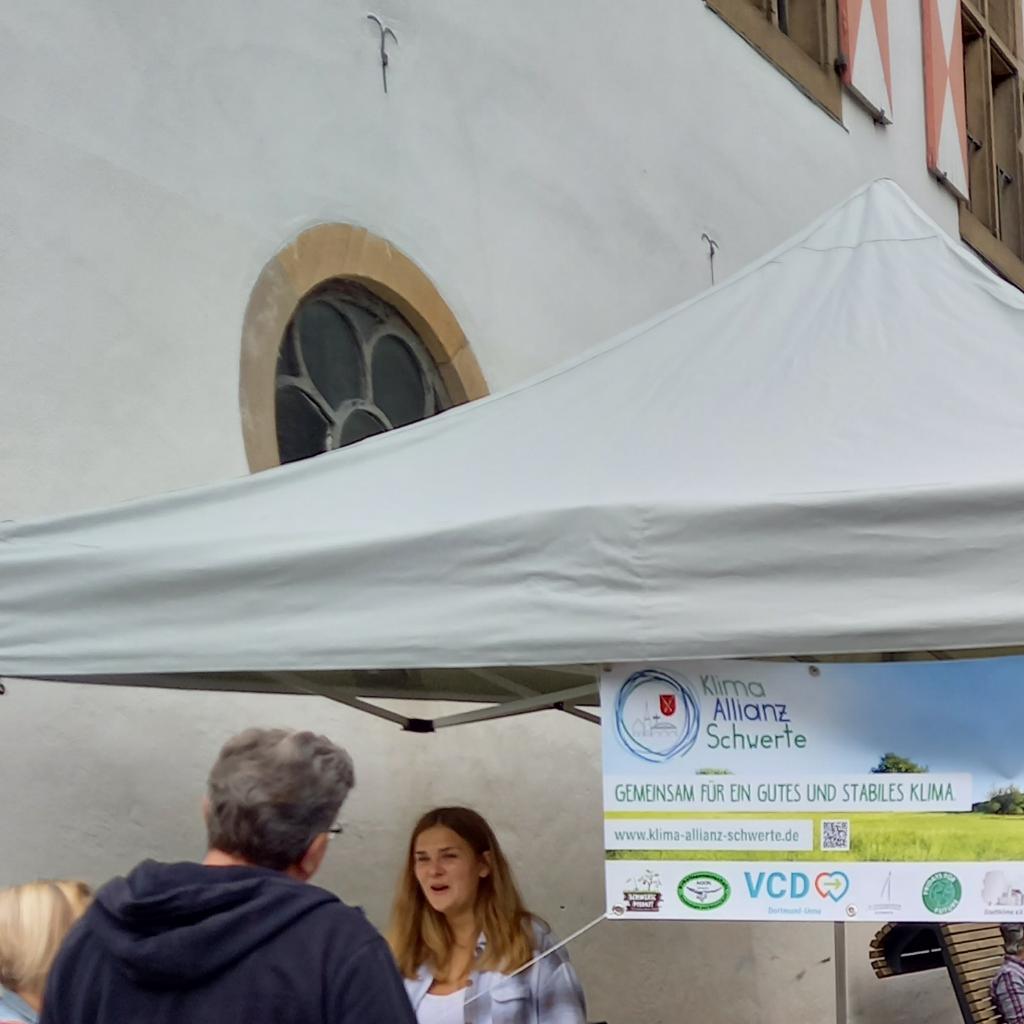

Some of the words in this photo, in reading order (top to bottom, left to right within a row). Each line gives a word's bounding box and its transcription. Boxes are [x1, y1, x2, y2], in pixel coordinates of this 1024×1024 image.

[699, 674, 766, 698] Klima
[713, 698, 791, 723] Allianz
[706, 723, 808, 750] Schwerte
[614, 783, 695, 803] GEMEINSAM
[701, 780, 725, 803] FÜR
[730, 783, 752, 802] EIN
[757, 782, 802, 803] GUTES
[807, 782, 837, 802] UND
[842, 782, 905, 802] STABILES
[614, 826, 799, 844] www.klima-allianz-schwerte.de
[744, 871, 810, 899] VCD
